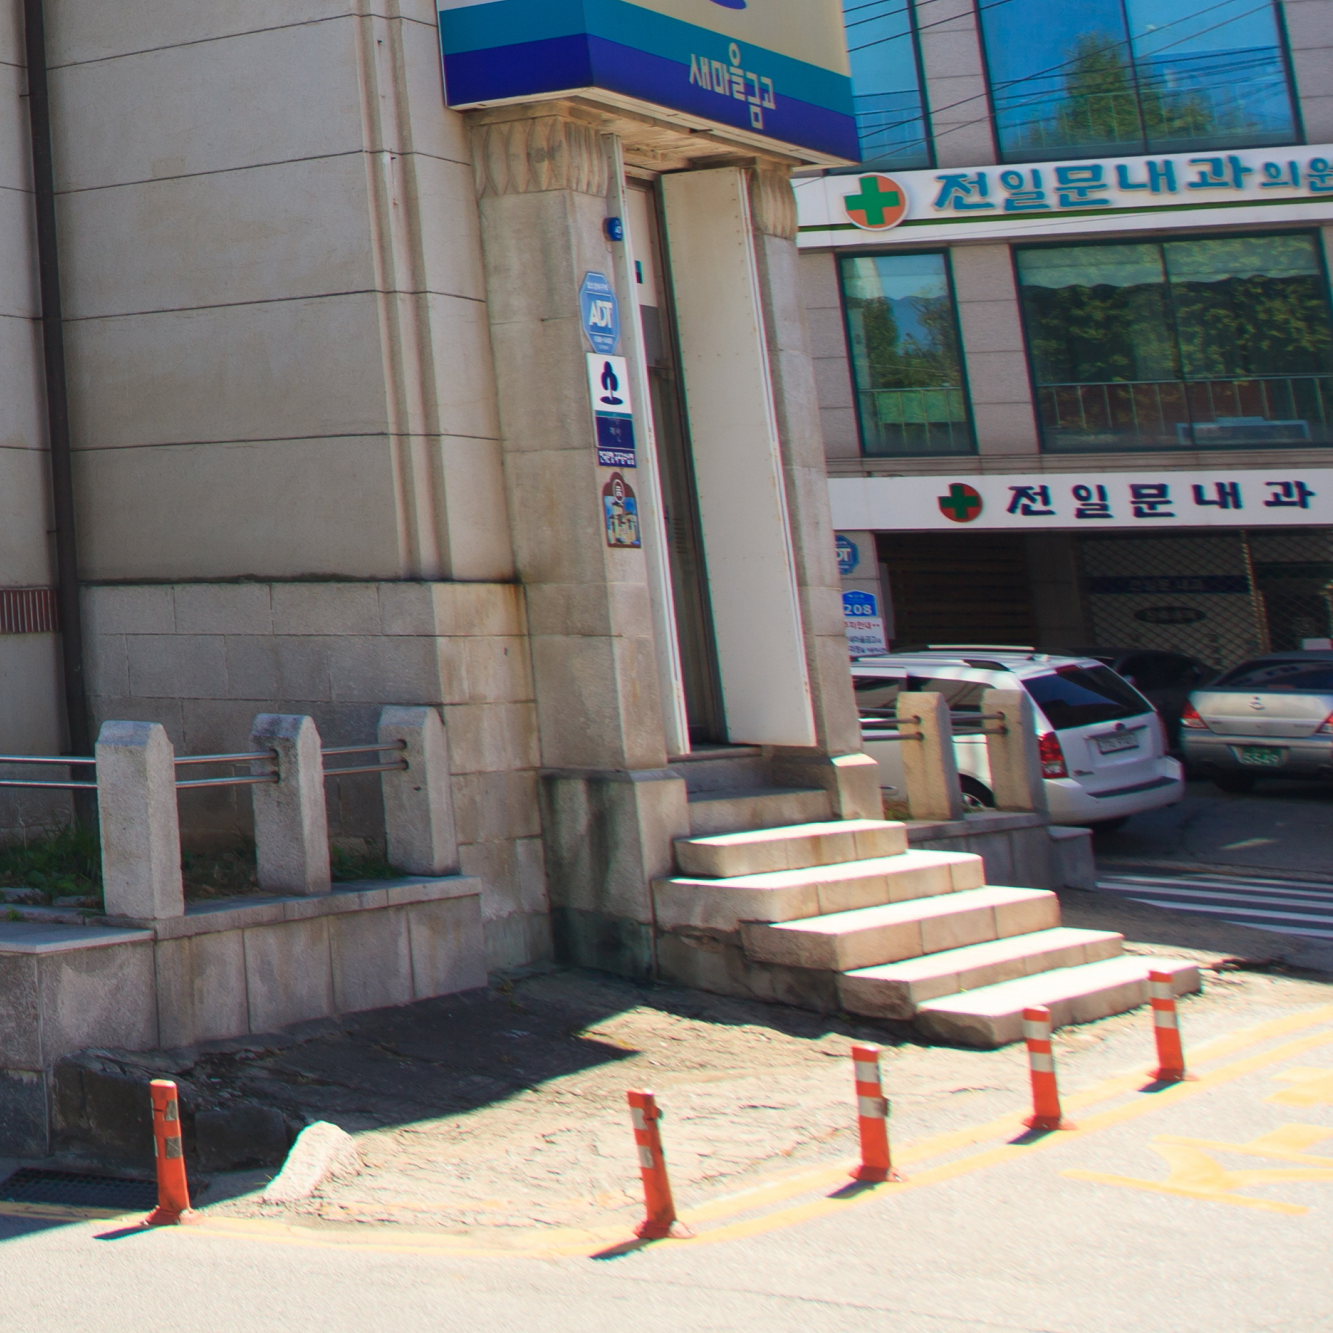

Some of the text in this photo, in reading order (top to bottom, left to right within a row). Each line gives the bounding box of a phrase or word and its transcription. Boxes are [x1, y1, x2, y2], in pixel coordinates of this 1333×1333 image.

[689, 42, 776, 130] 새마을금고
[588, 299, 613, 328] ADT
[1006, 480, 1316, 519] 전일문내과
[835, 548, 852, 562] DT
[843, 604, 872, 615] 208
